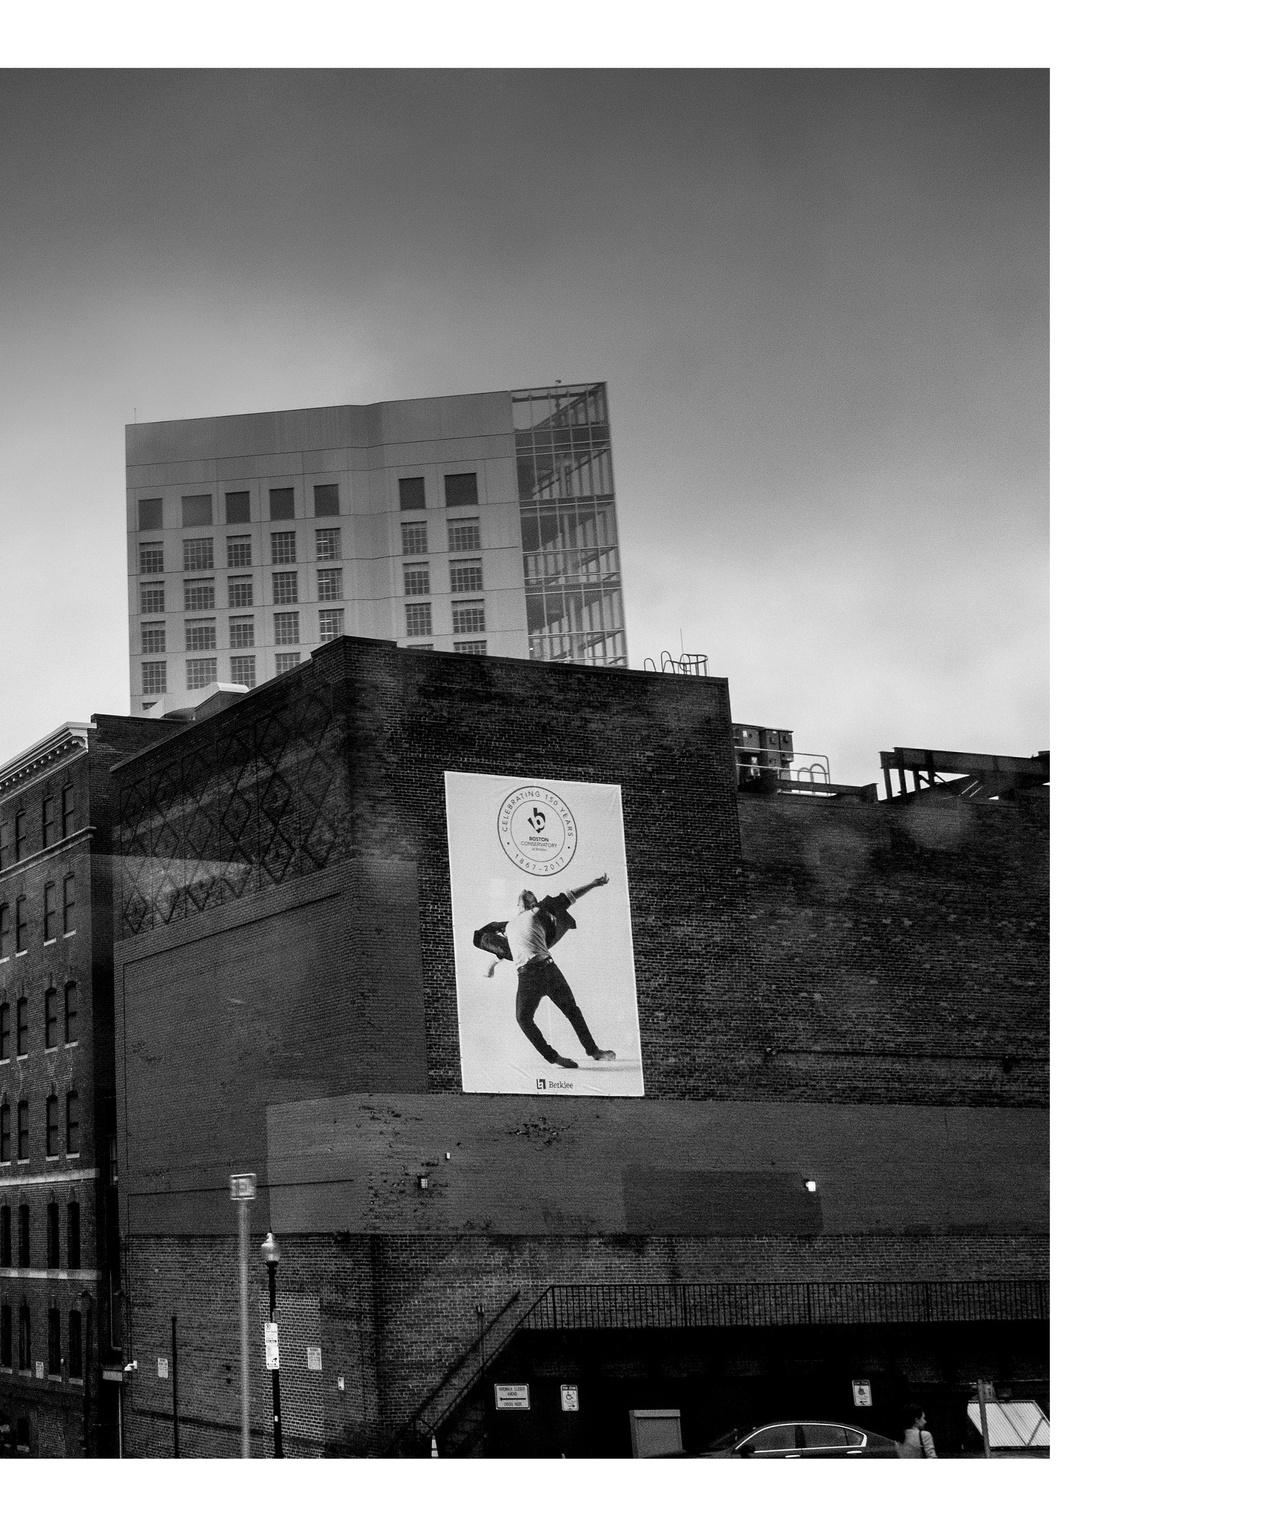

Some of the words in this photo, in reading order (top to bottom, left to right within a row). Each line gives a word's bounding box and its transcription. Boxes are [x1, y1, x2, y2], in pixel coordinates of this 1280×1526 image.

[502, 790, 541, 832] CELEBRATING
[545, 794, 558, 806] 150
[560, 807, 574, 837] YEARS
[515, 853, 565, 872] 1867-2017
[549, 1080, 573, 1089] Berklee
